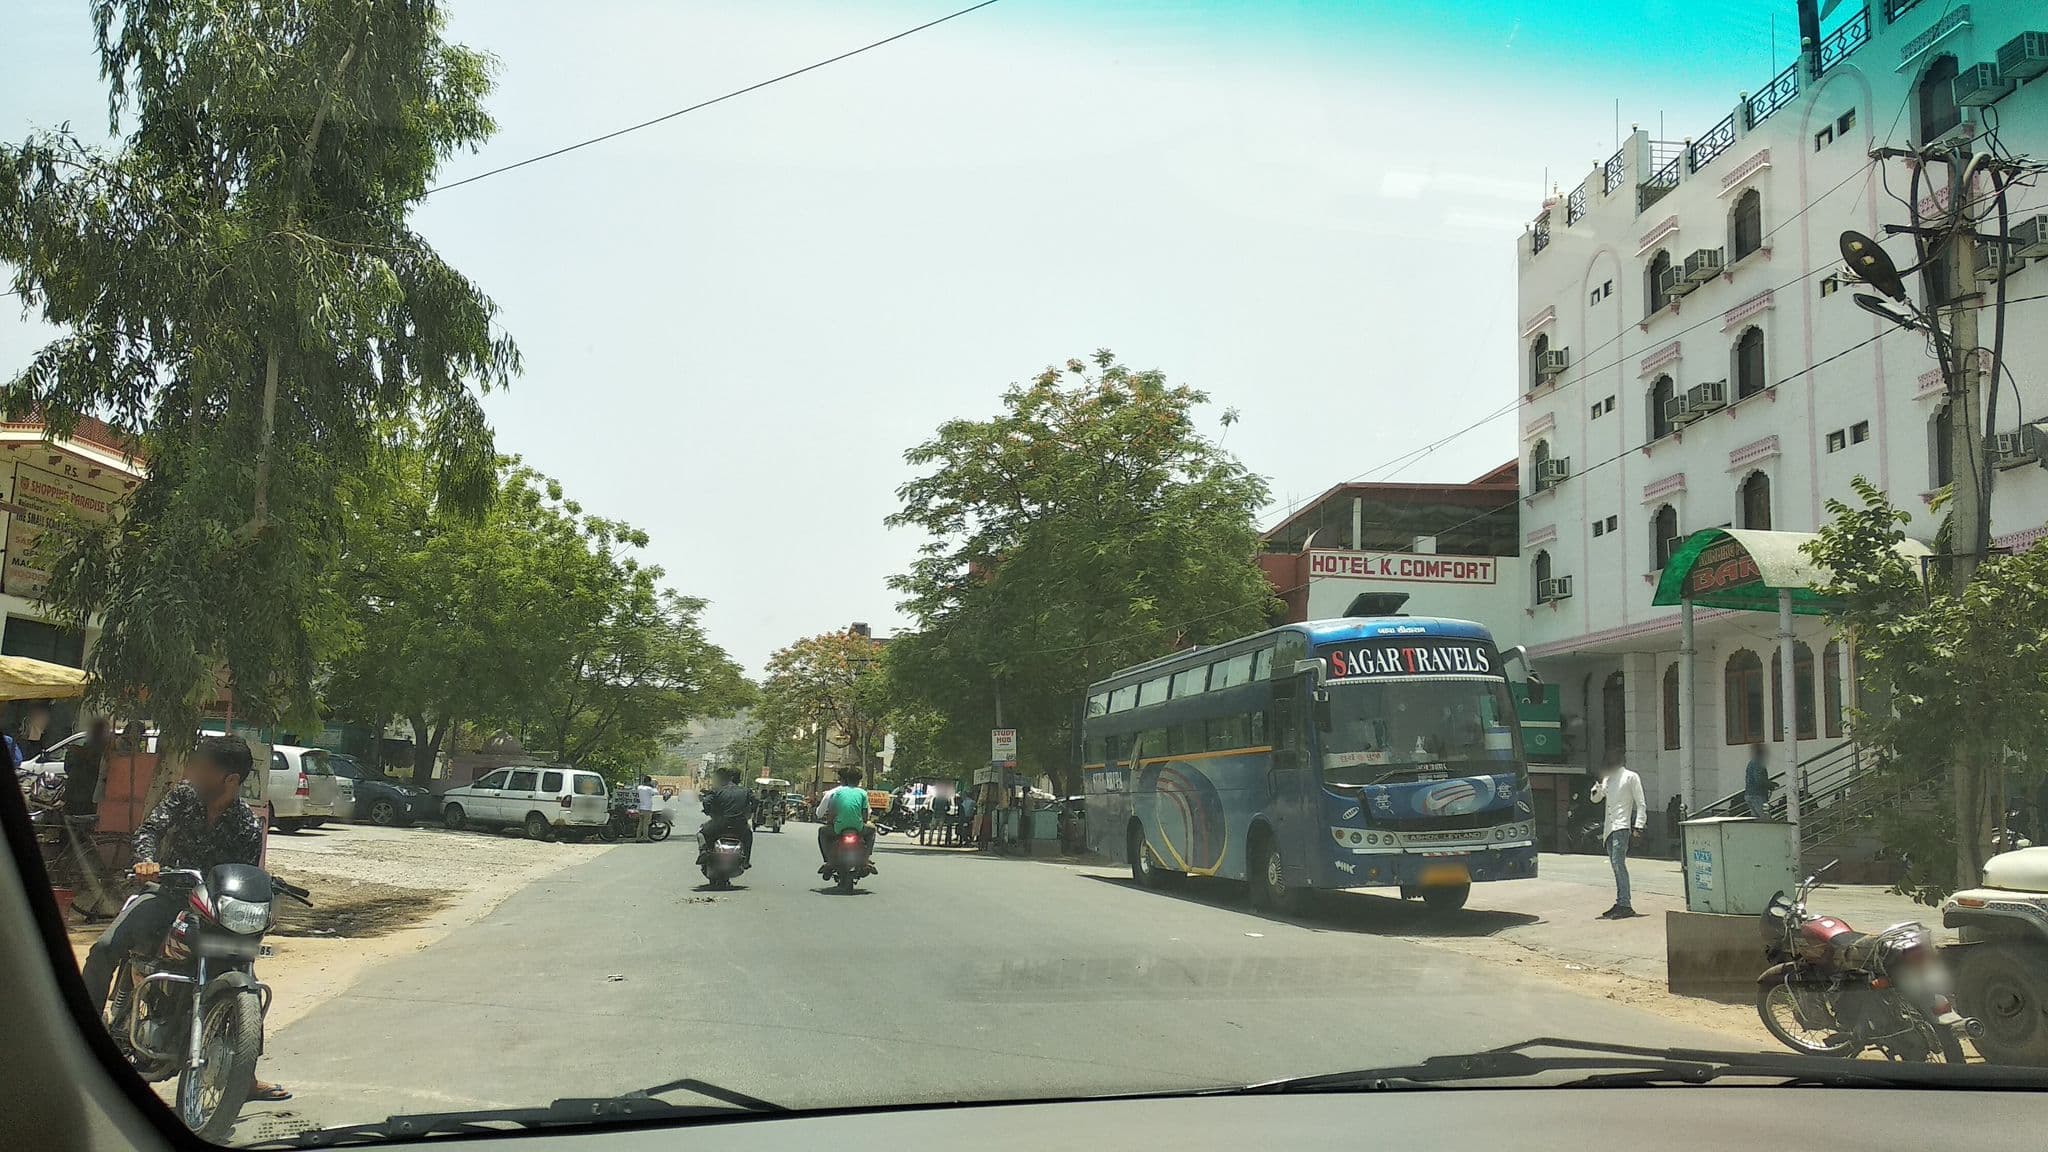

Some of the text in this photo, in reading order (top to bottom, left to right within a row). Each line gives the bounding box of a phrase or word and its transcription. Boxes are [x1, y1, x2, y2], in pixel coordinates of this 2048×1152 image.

[31, 480, 69, 500] SHOPPING
[70, 492, 105, 513] PARADISE
[1312, 555, 1491, 580] HOTEL K. COMFORT
[1331, 647, 1490, 677] SAGAR TRAVELS
